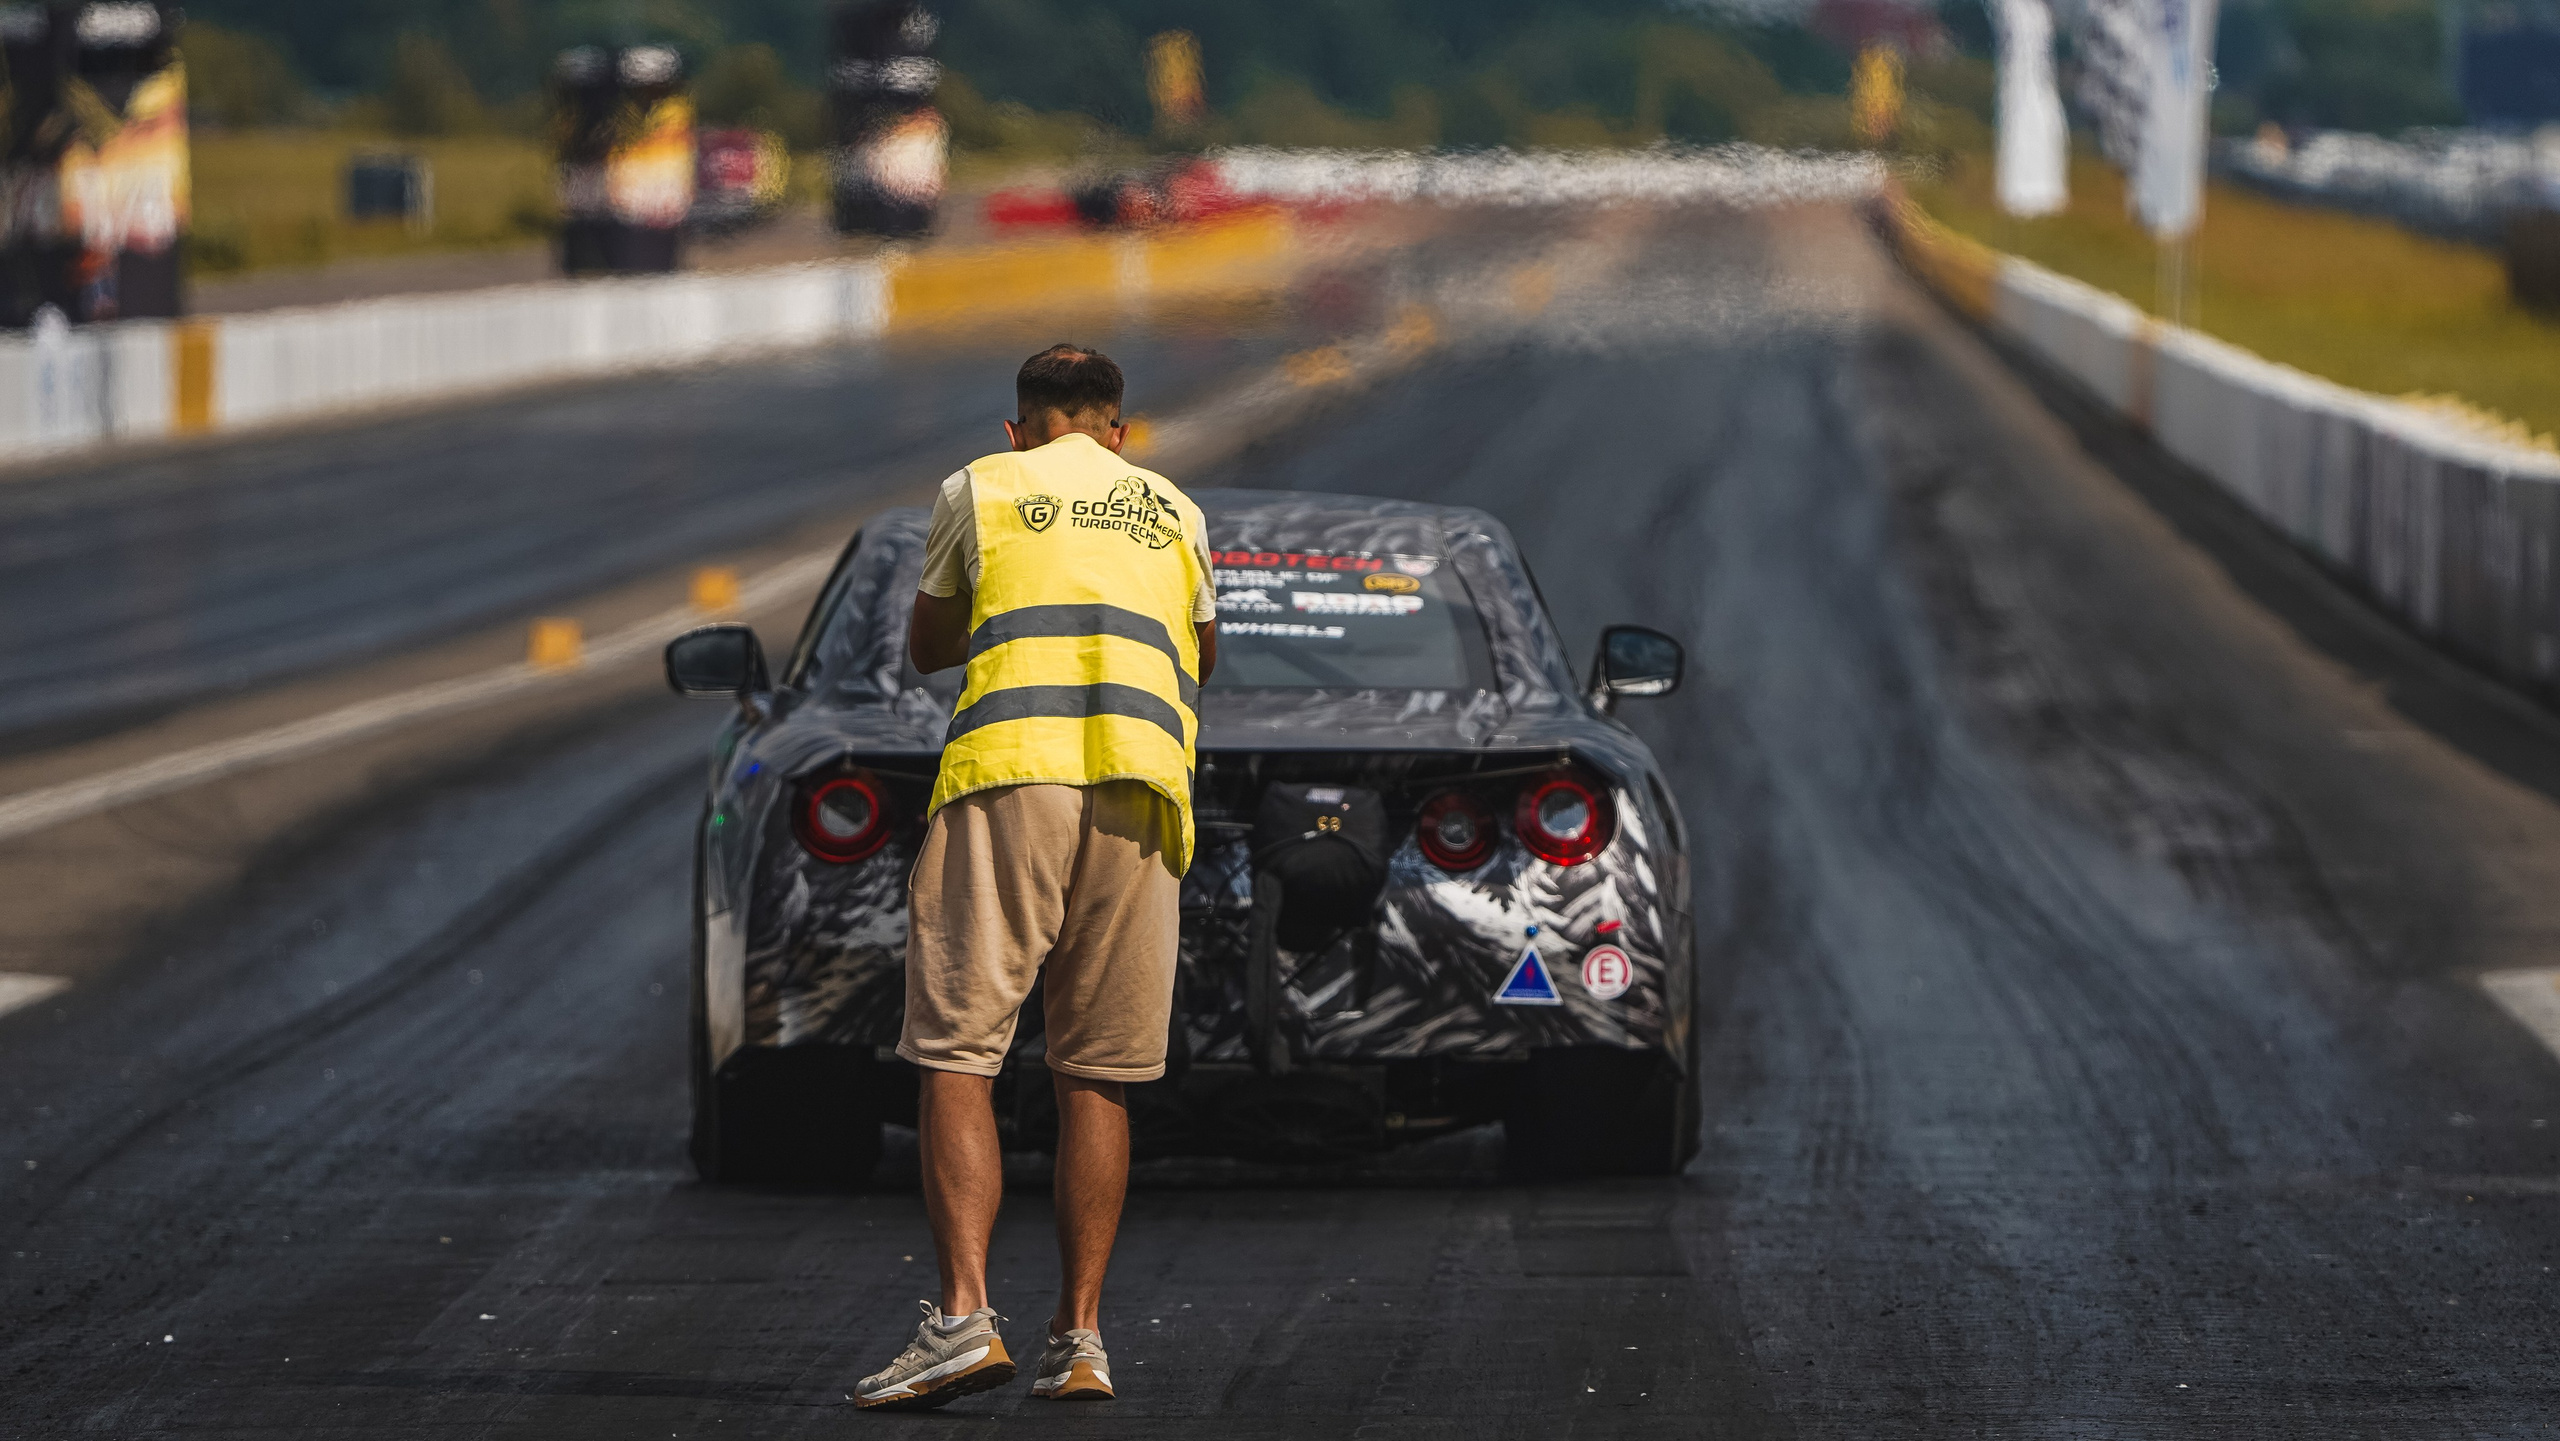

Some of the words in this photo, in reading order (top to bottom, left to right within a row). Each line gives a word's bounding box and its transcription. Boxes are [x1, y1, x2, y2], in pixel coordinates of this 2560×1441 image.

[1031, 506, 1047, 523] G
[1071, 500, 1160, 529] GOSHA
[1071, 517, 1154, 541] TURBOTECH
[1155, 523, 1184, 543] MEDIA
[1220, 622, 1346, 639] WHEELS
[1599, 958, 1614, 984] E
